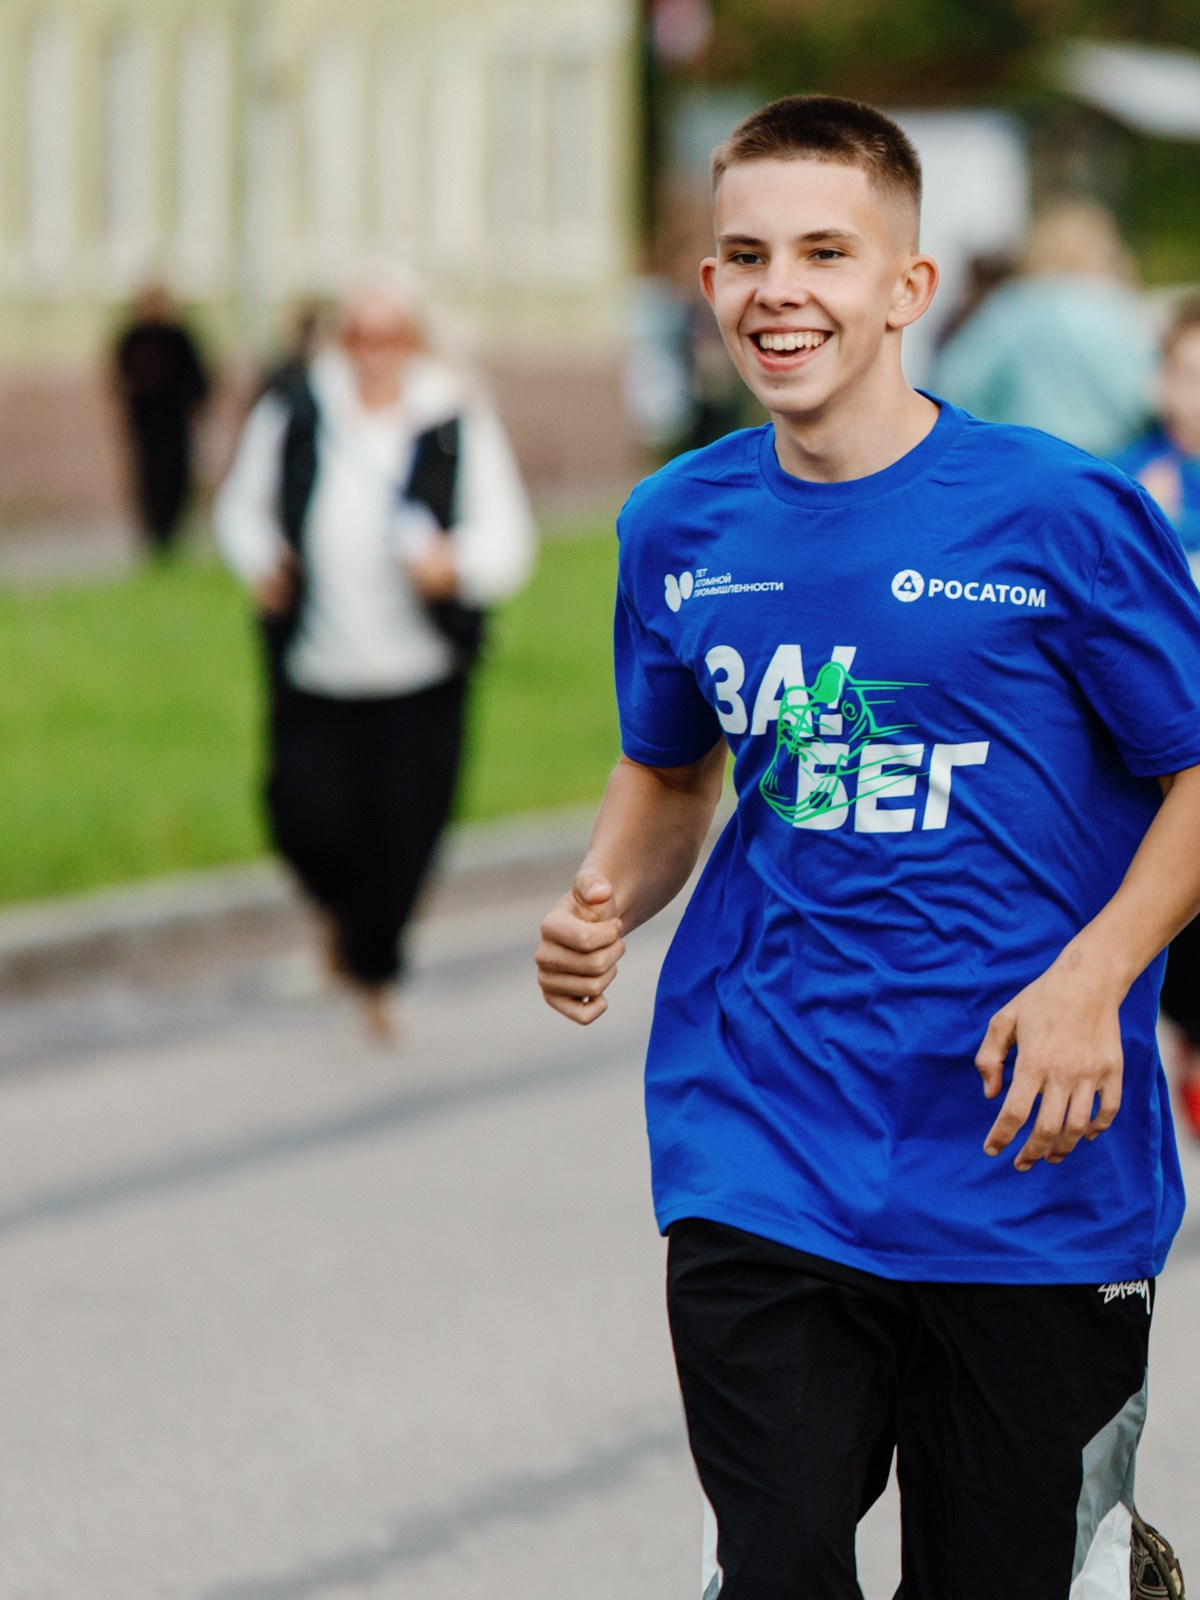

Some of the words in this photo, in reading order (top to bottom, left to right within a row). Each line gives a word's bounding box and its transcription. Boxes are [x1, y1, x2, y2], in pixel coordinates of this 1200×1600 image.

[693, 581, 784, 598] ПРОМЫШЛЕННОСТИ
[694, 572, 732, 588] АТОМНОЙ
[927, 578, 1047, 609] РОСАТОМ
[792, 740, 990, 833] БЕГ
